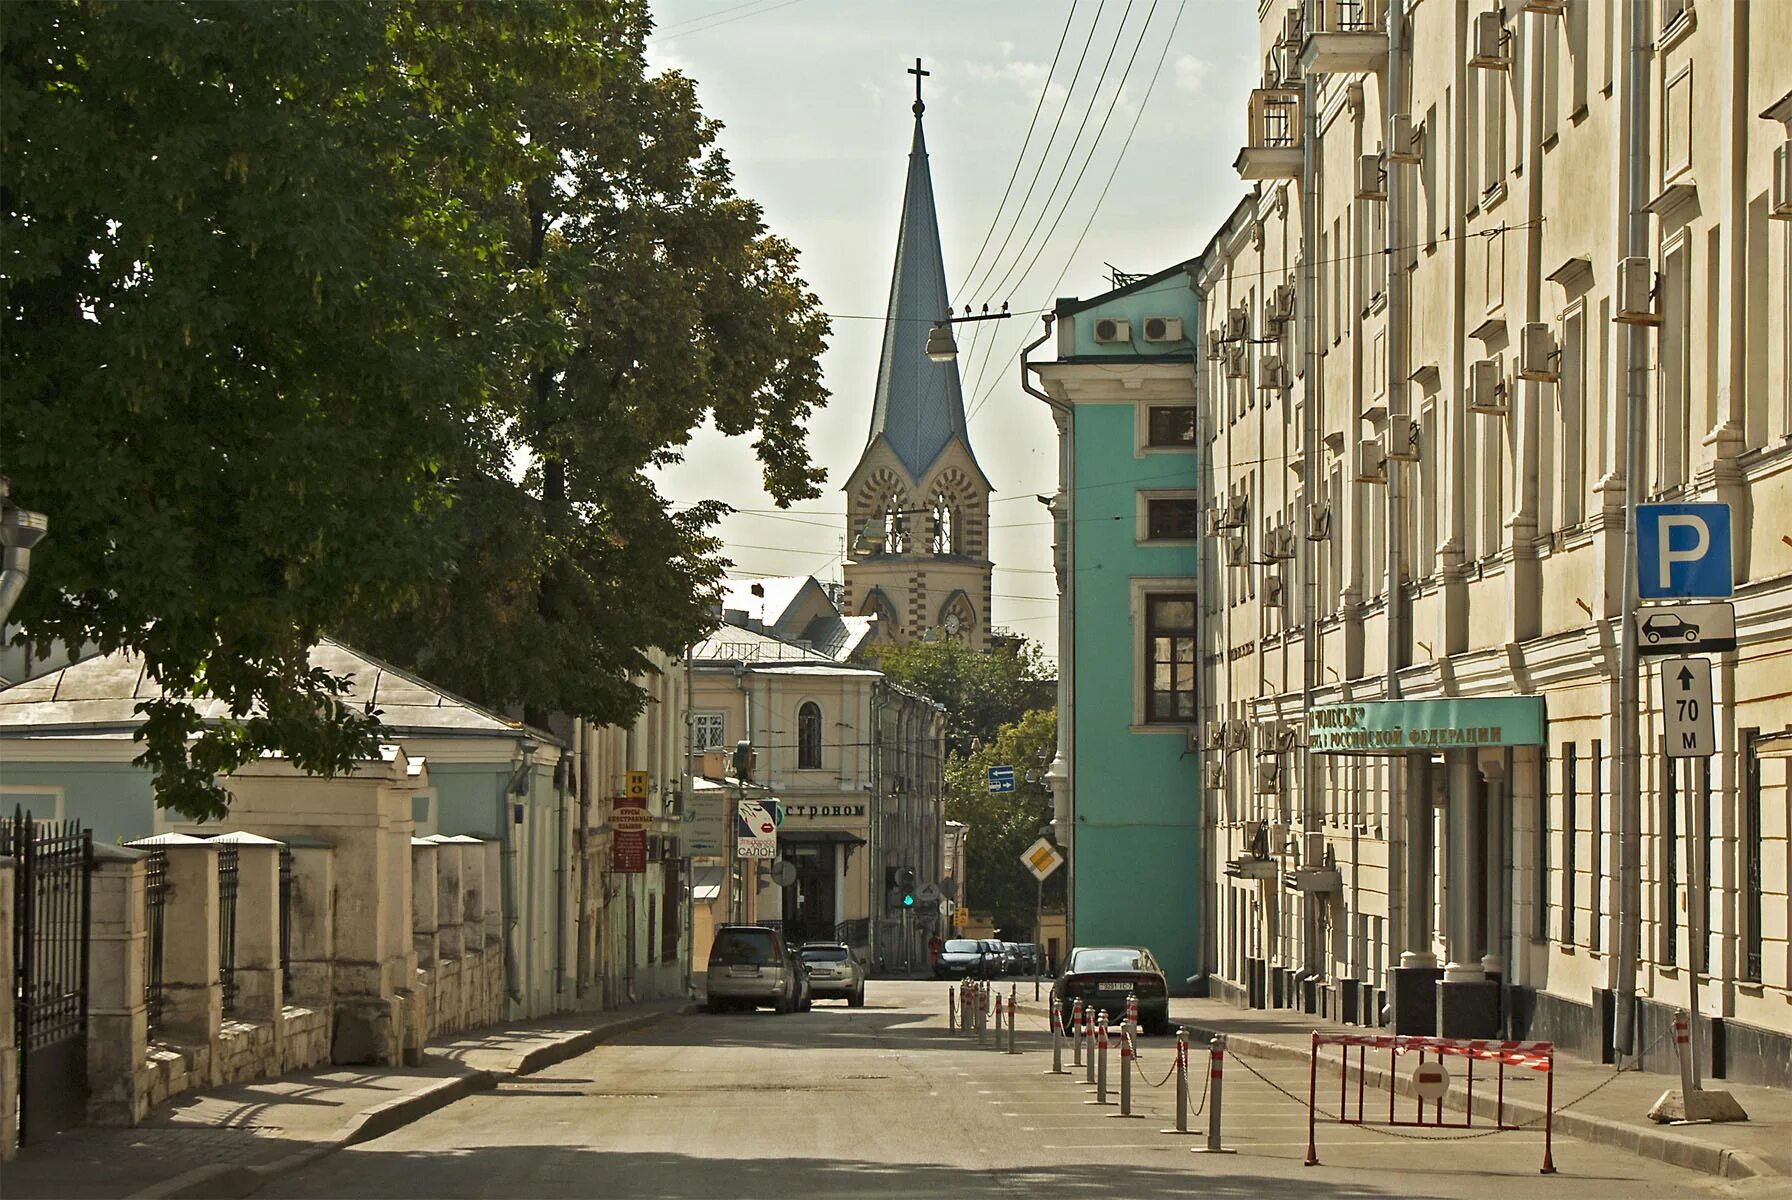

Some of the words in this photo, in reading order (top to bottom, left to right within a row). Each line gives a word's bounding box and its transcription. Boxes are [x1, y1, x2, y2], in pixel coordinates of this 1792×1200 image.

[1658, 514, 1710, 588] P
[1676, 700, 1699, 722] 70
[1408, 727, 1502, 745] ФЕДЕРАЦИИ
[738, 847, 776, 857] САЛОН
